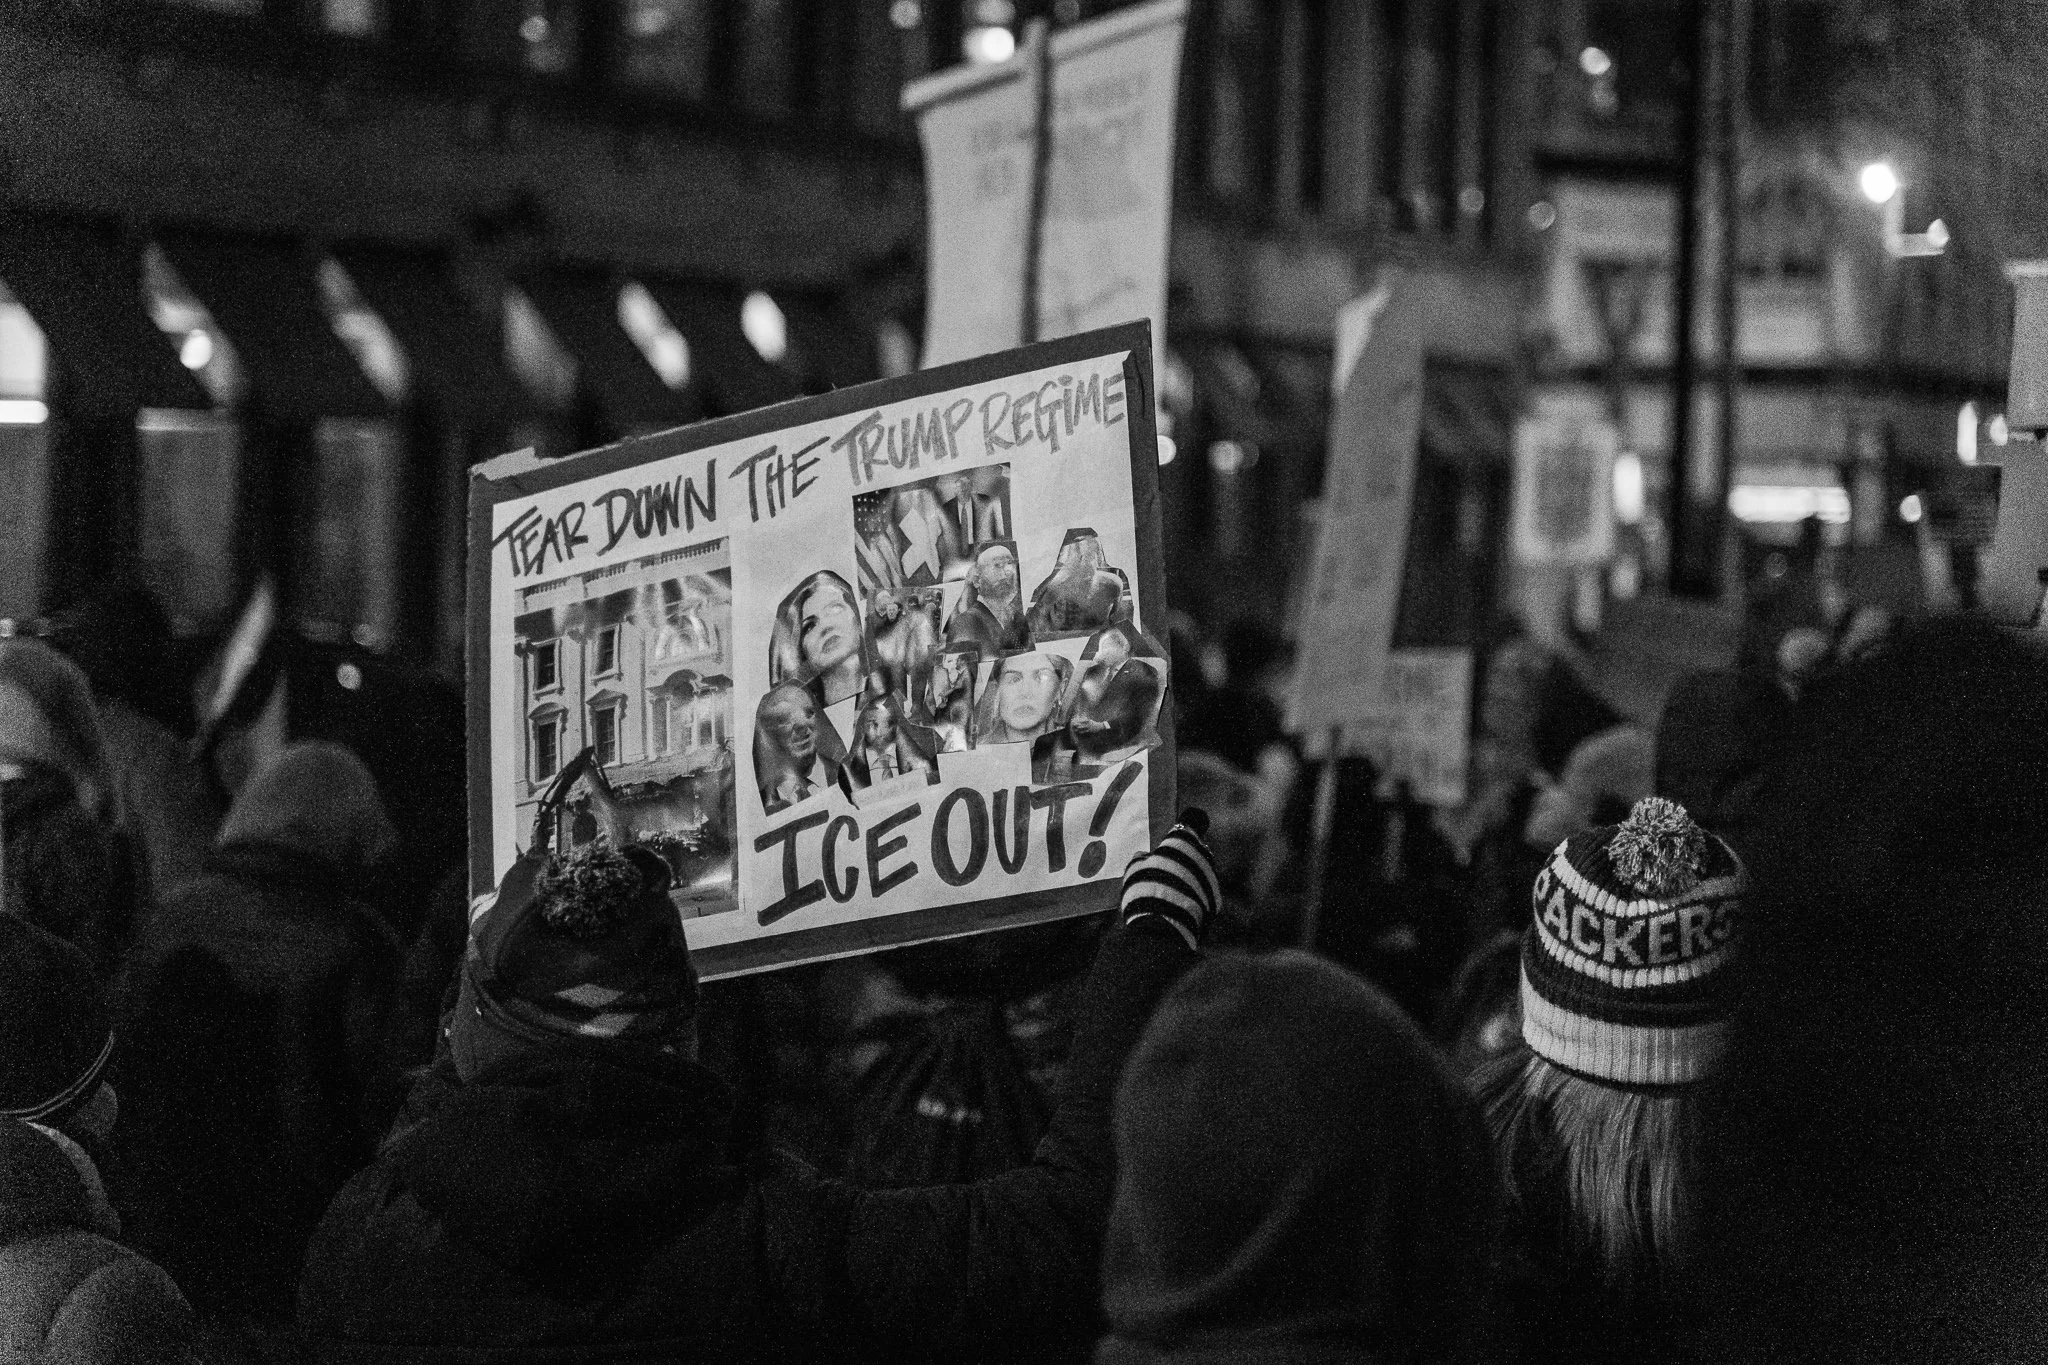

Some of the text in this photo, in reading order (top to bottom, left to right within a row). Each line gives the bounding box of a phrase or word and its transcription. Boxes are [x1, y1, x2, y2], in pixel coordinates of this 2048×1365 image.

[493, 502, 590, 577] TEAR
[592, 458, 717, 556] DOWN
[729, 436, 830, 523] THE
[831, 397, 974, 487] TRUMP
[754, 760, 1144, 927] ICE OUT!
